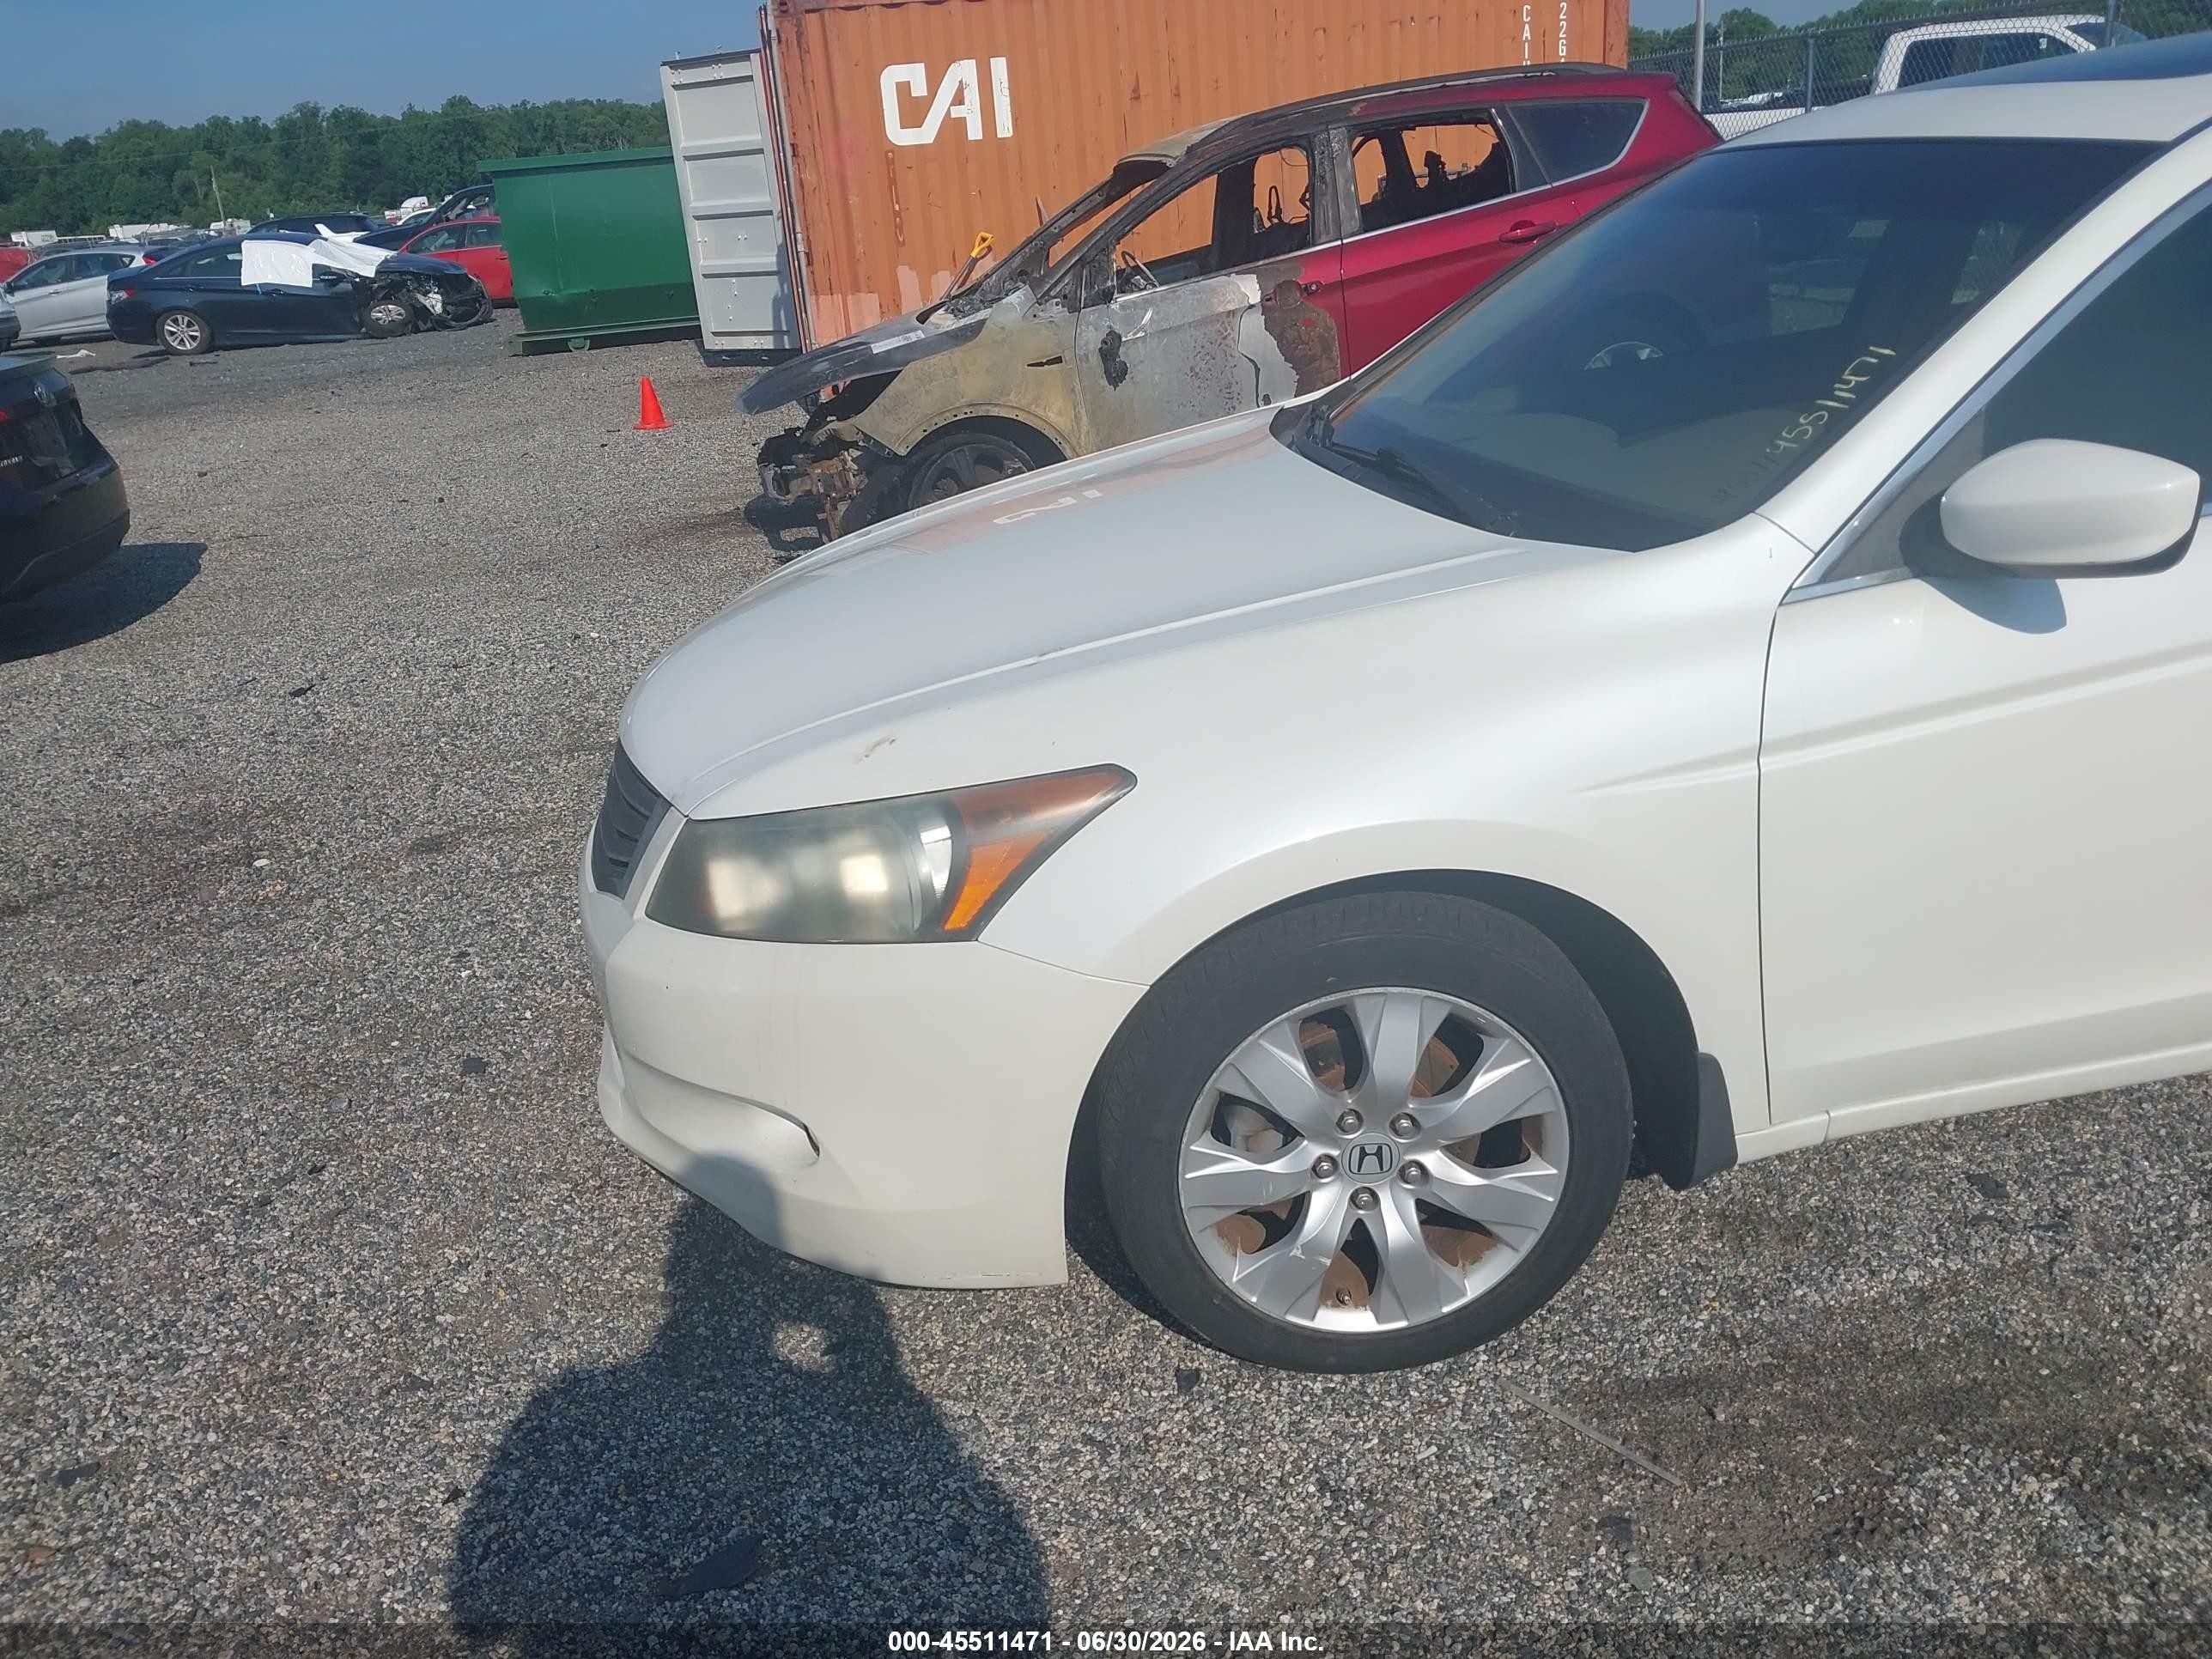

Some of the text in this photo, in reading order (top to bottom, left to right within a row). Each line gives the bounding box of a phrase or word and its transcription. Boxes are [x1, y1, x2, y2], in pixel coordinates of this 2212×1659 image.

[1522, 5, 1531, 65] CAI
[1559, 2, 1567, 62] 22G
[880, 57, 1013, 146] CAI
[1766, 346, 1896, 453] 45511471
